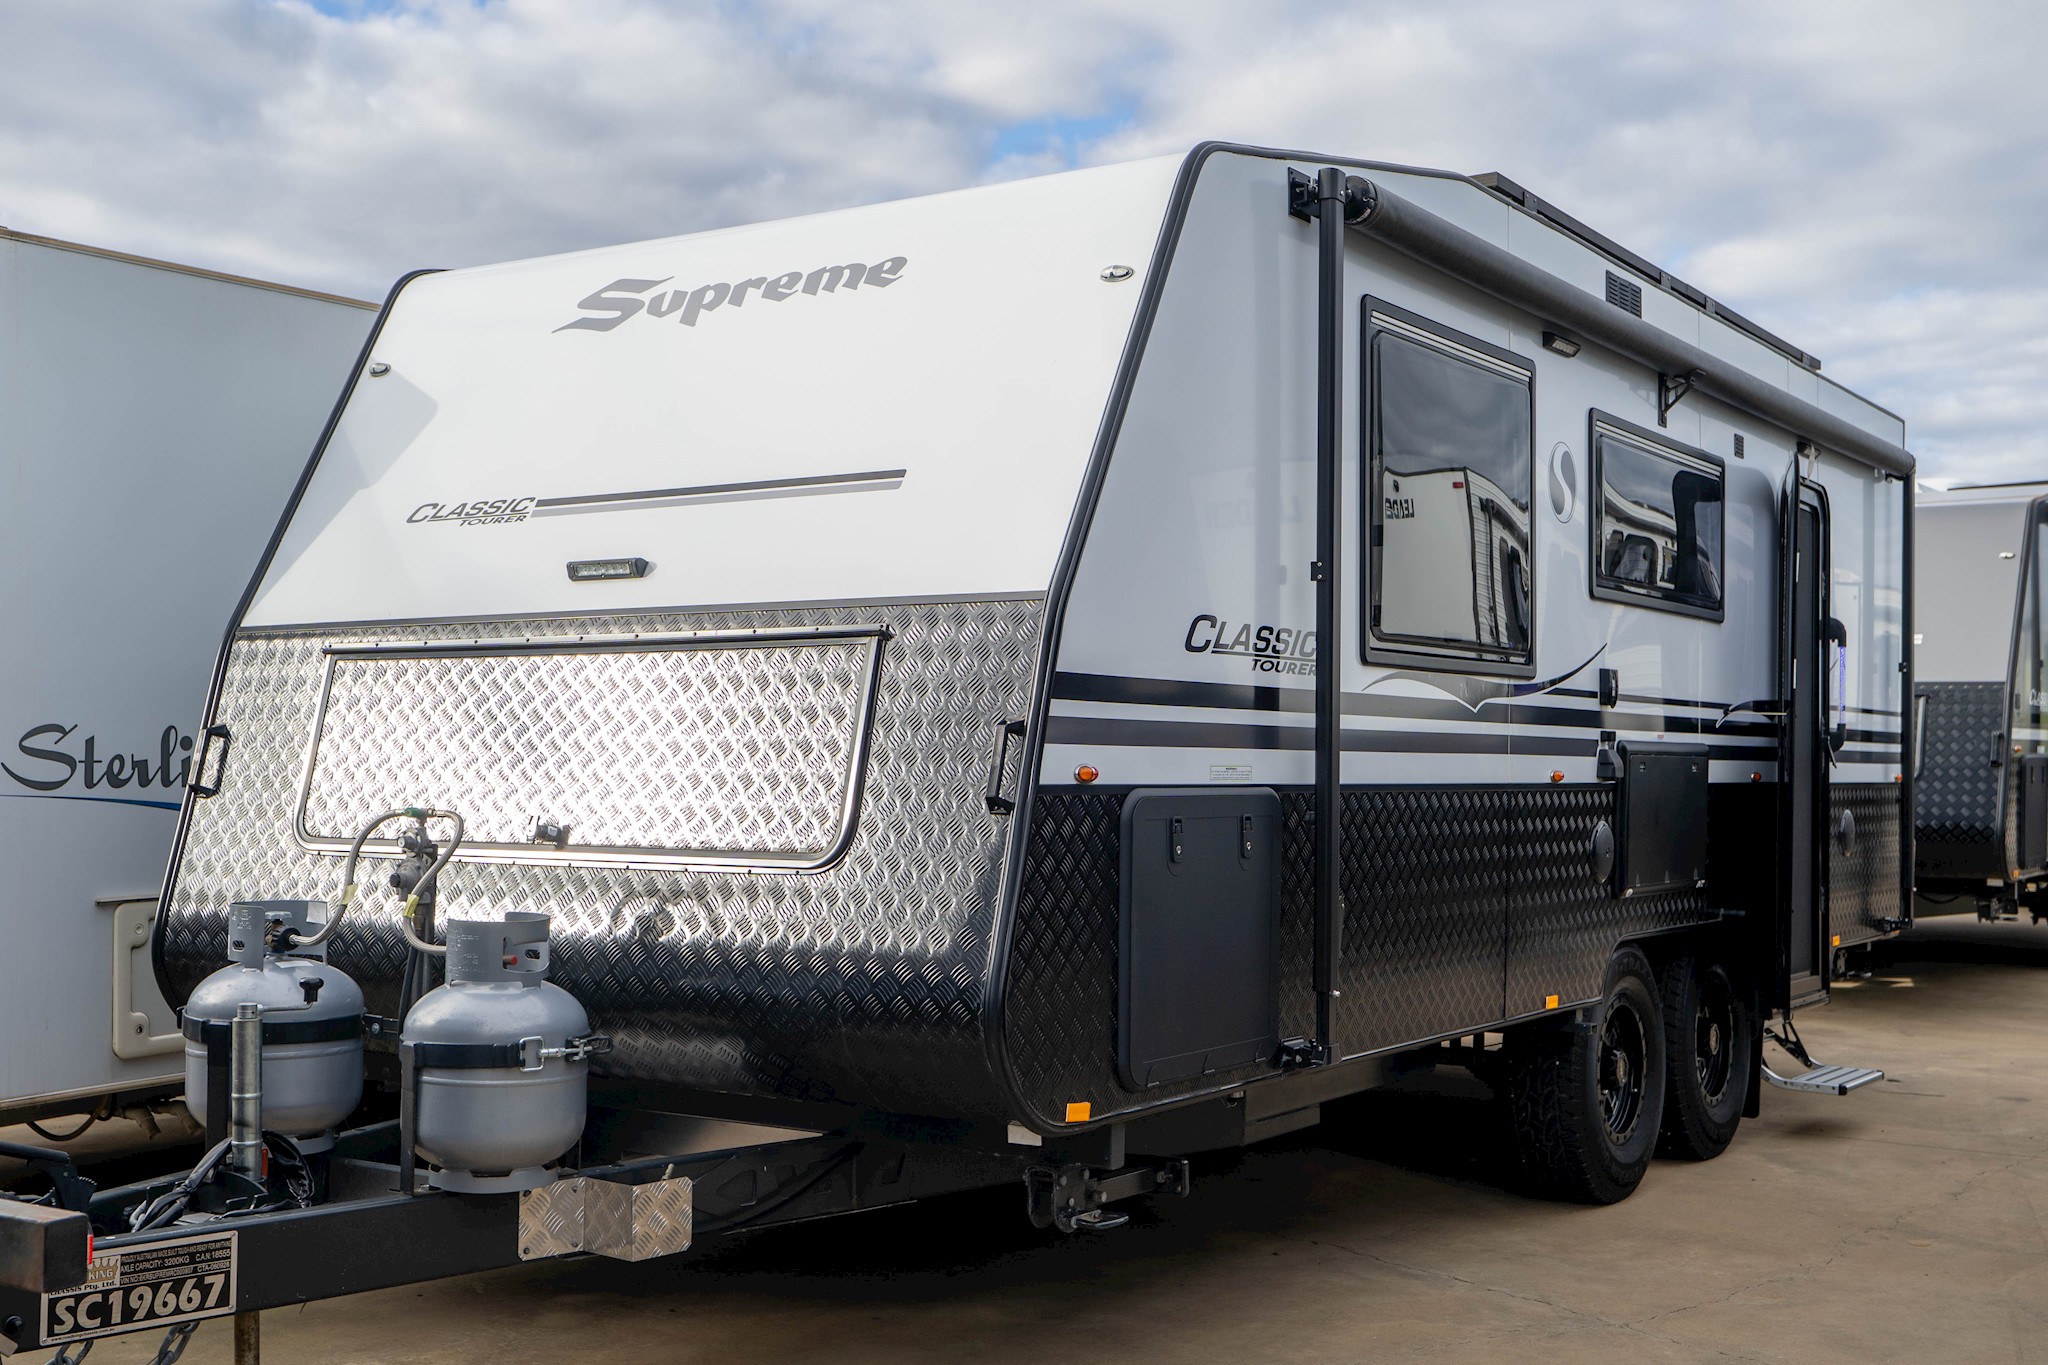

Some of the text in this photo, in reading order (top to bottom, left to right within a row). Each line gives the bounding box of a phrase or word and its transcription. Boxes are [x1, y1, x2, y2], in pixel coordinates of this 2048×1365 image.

[551, 256, 907, 334] Supreme
[406, 497, 536, 523] CLASSIC
[459, 514, 527, 527] TOURER
[164, 1255, 190, 1266] 3200KG
[88, 1268, 113, 1280] KING
[54, 1274, 225, 1334] SC19667
